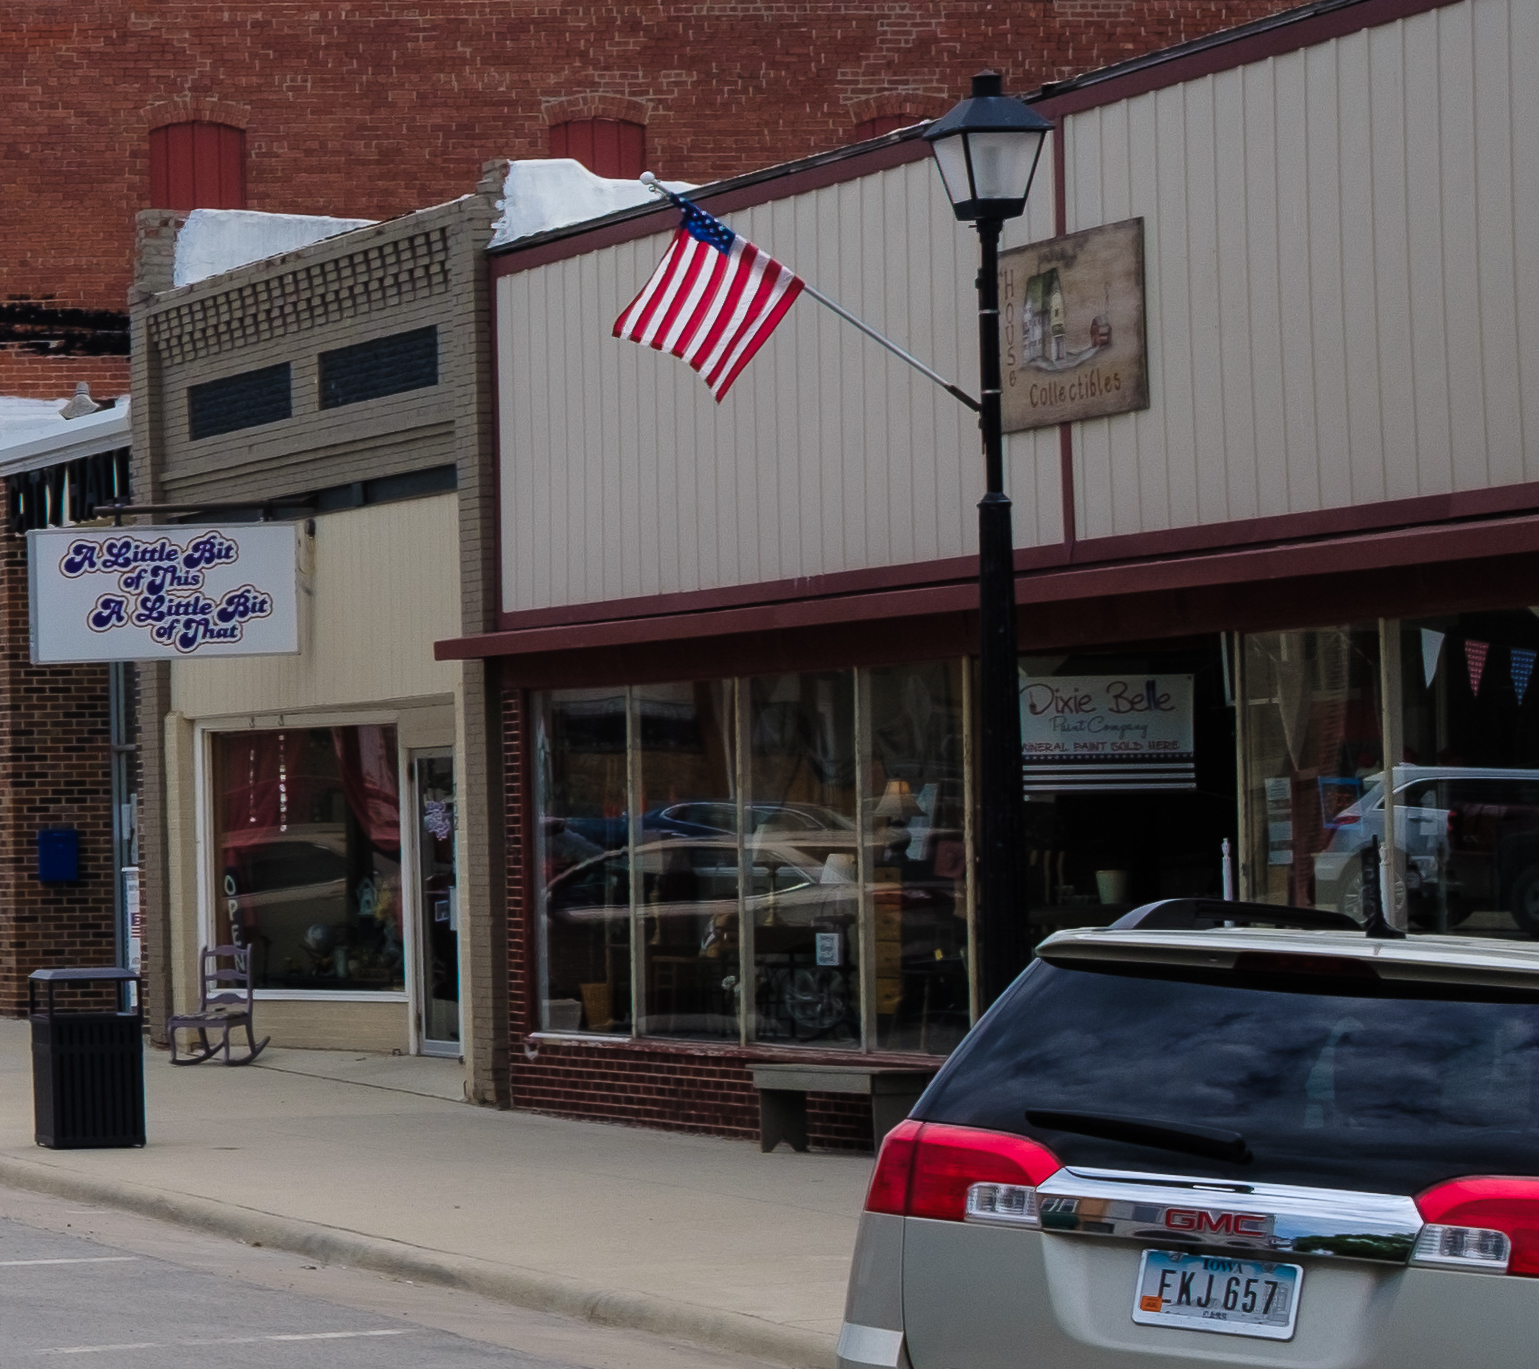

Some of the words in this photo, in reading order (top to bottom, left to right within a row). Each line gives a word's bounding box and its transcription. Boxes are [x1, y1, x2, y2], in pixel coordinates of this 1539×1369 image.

[1029, 368, 1121, 408] Collectibles
[63, 543, 97, 574] A
[101, 538, 179, 569] Little
[183, 535, 234, 570] Bit
[123, 568, 148, 590] of
[146, 564, 201, 595] This
[91, 597, 126, 628] A
[135, 594, 213, 623] Little
[216, 588, 268, 624] Bit
[155, 619, 181, 641] of
[178, 617, 239, 649] That
[1019, 683, 1097, 716] Dixie
[1106, 679, 1176, 714] Belle
[1048, 715, 1088, 732] Paint
[1087, 716, 1149, 739] Company
[1148, 740, 1180, 751] HERE
[1164, 1207, 1267, 1238] GMC
[1202, 1258, 1243, 1274] IOWA
[1158, 1268, 1215, 1308] EKJ
[1223, 1275, 1278, 1315] 657
